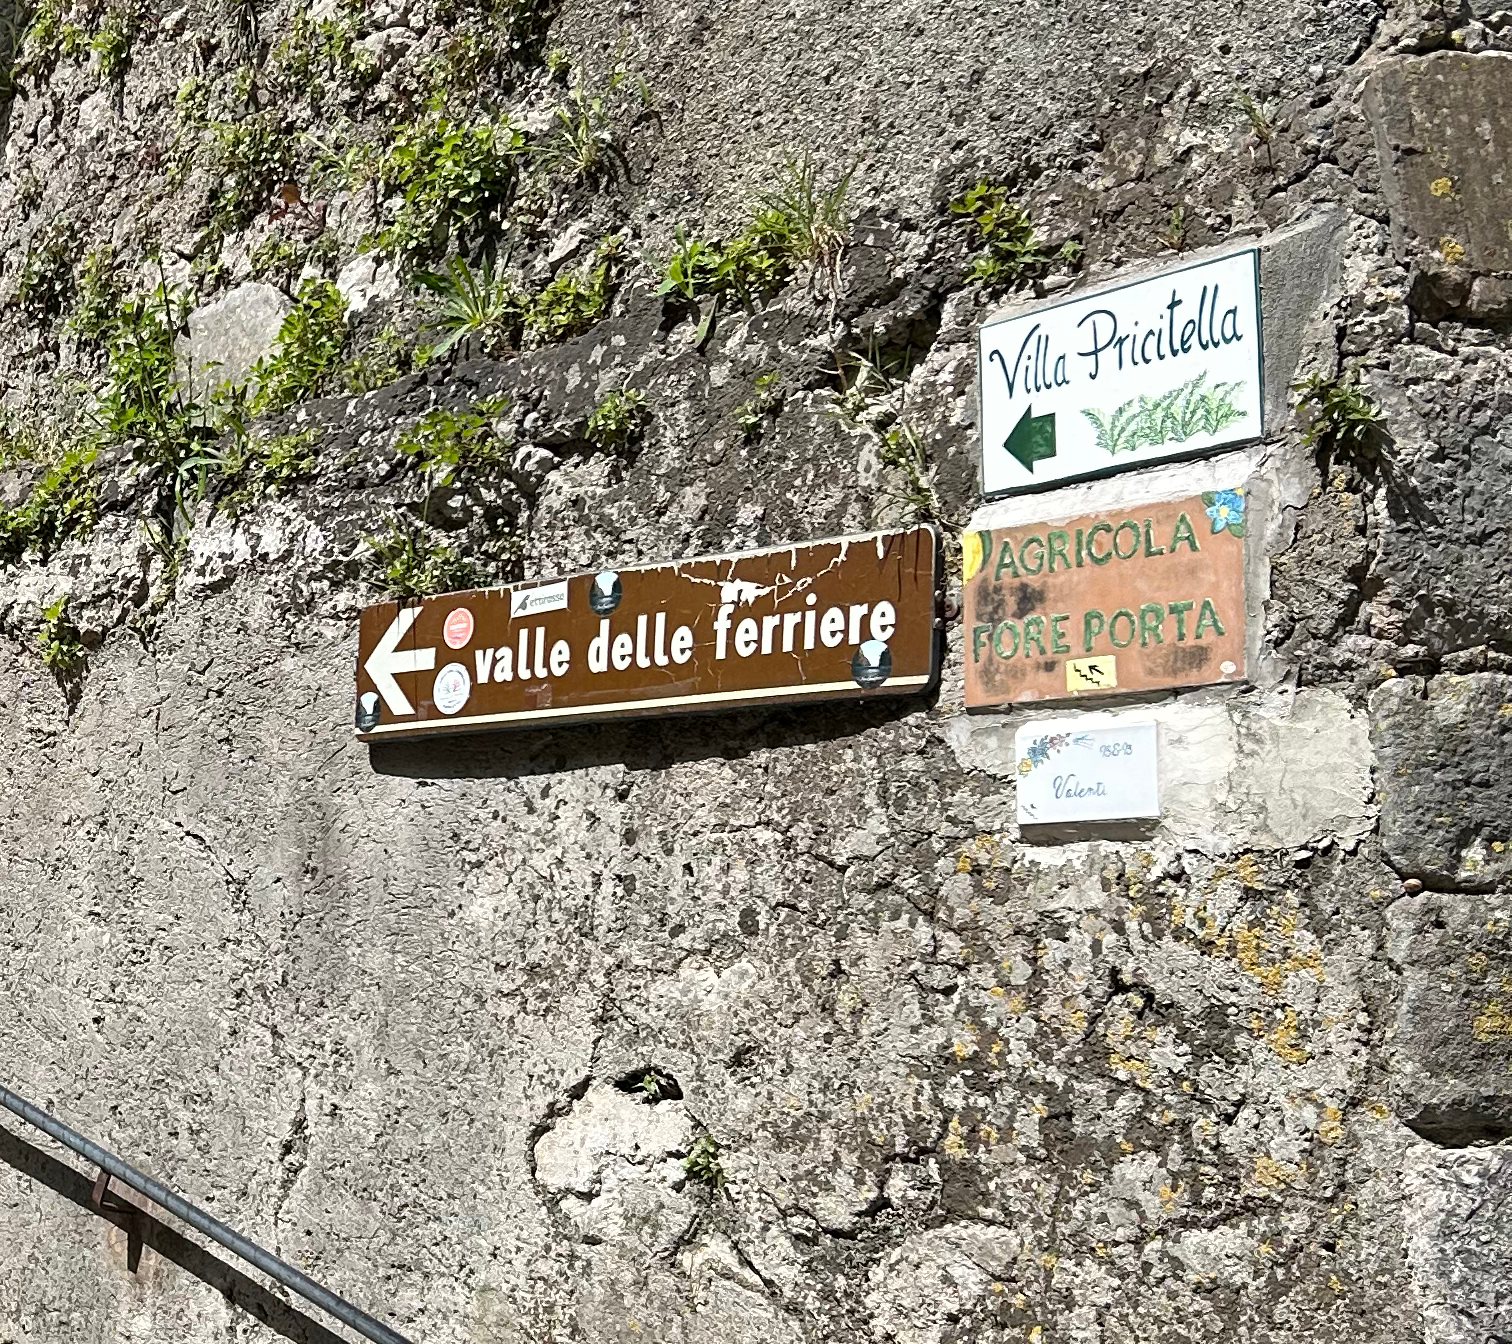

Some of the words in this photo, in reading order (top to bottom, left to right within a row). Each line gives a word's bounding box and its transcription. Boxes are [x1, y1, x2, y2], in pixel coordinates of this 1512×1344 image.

[990, 323, 1070, 399] Villa
[1077, 283, 1244, 380] Pricitella
[994, 511, 1201, 581] AGRICOLA
[474, 626, 571, 685] valle
[587, 612, 694, 675] delle
[712, 594, 897, 661] ferriere
[972, 613, 1071, 663] FORE
[1083, 598, 1226, 653] PORTA
